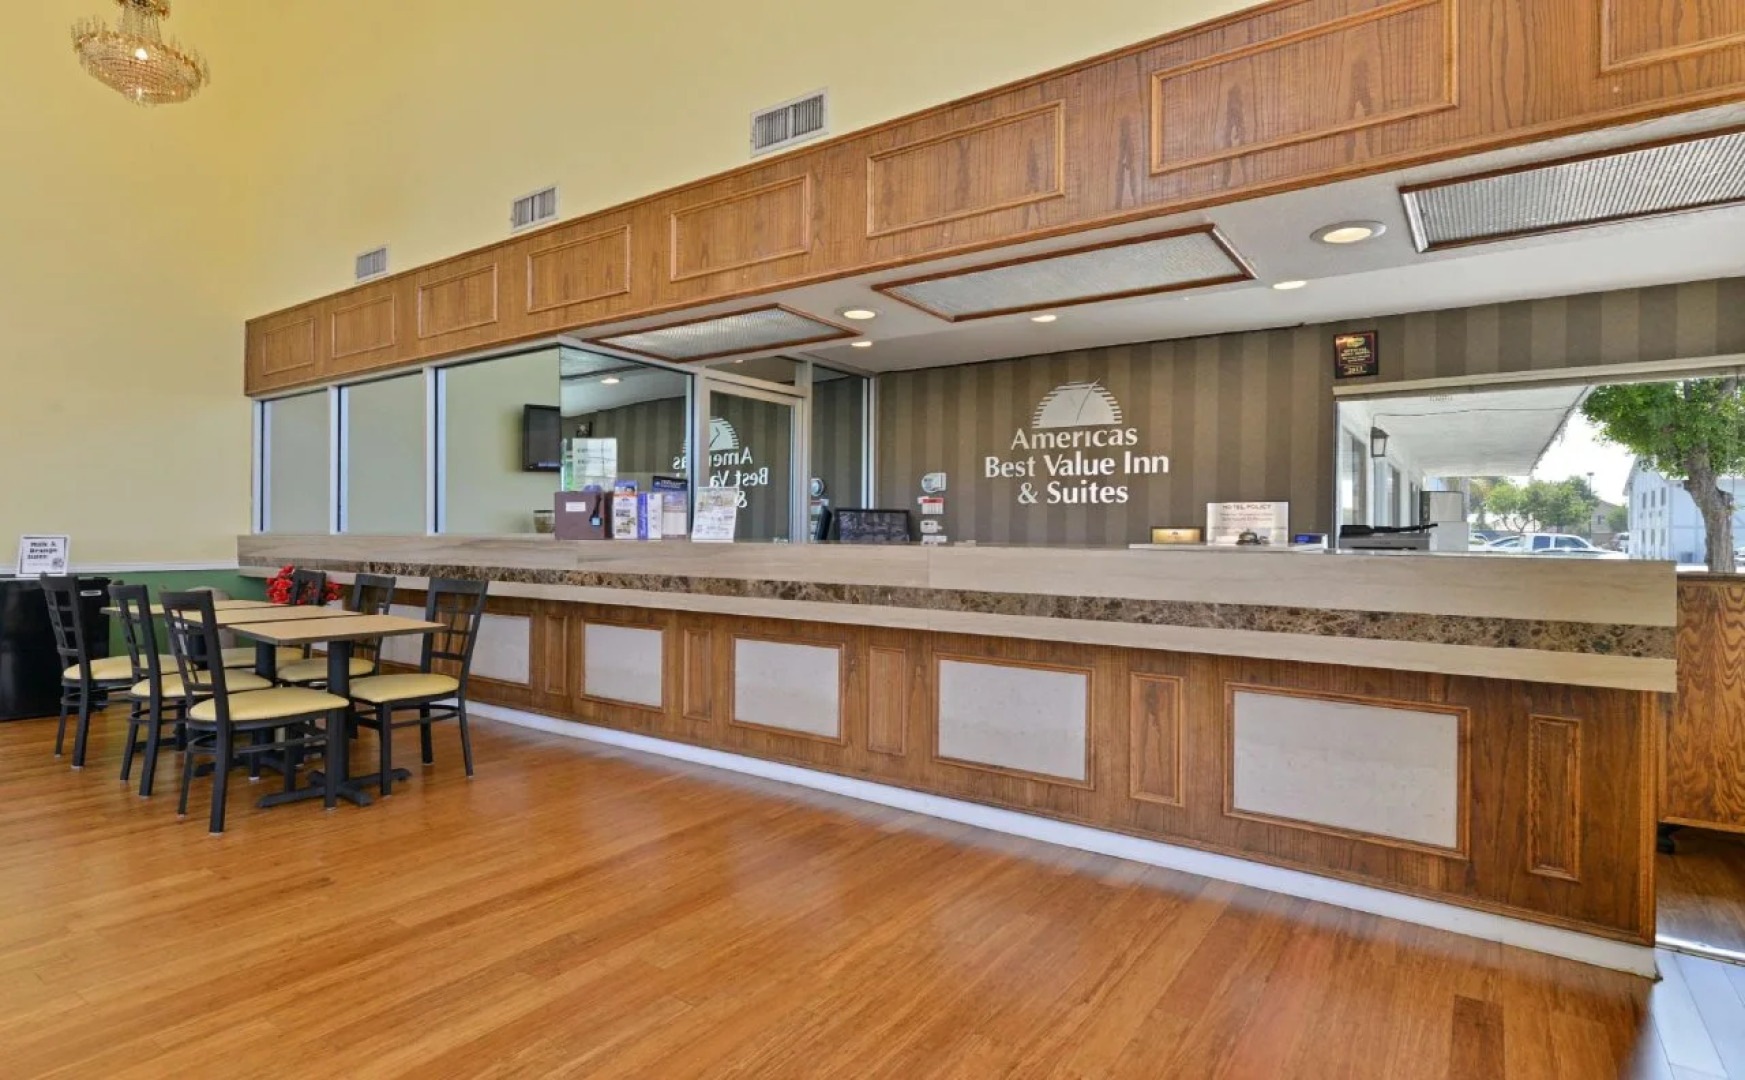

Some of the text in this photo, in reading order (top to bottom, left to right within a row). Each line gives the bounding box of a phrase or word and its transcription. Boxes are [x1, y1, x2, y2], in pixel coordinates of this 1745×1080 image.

[1011, 427, 1138, 450] Americas
[985, 451, 1169, 478] Best Value Inn
[1017, 480, 1129, 504] & Suites
